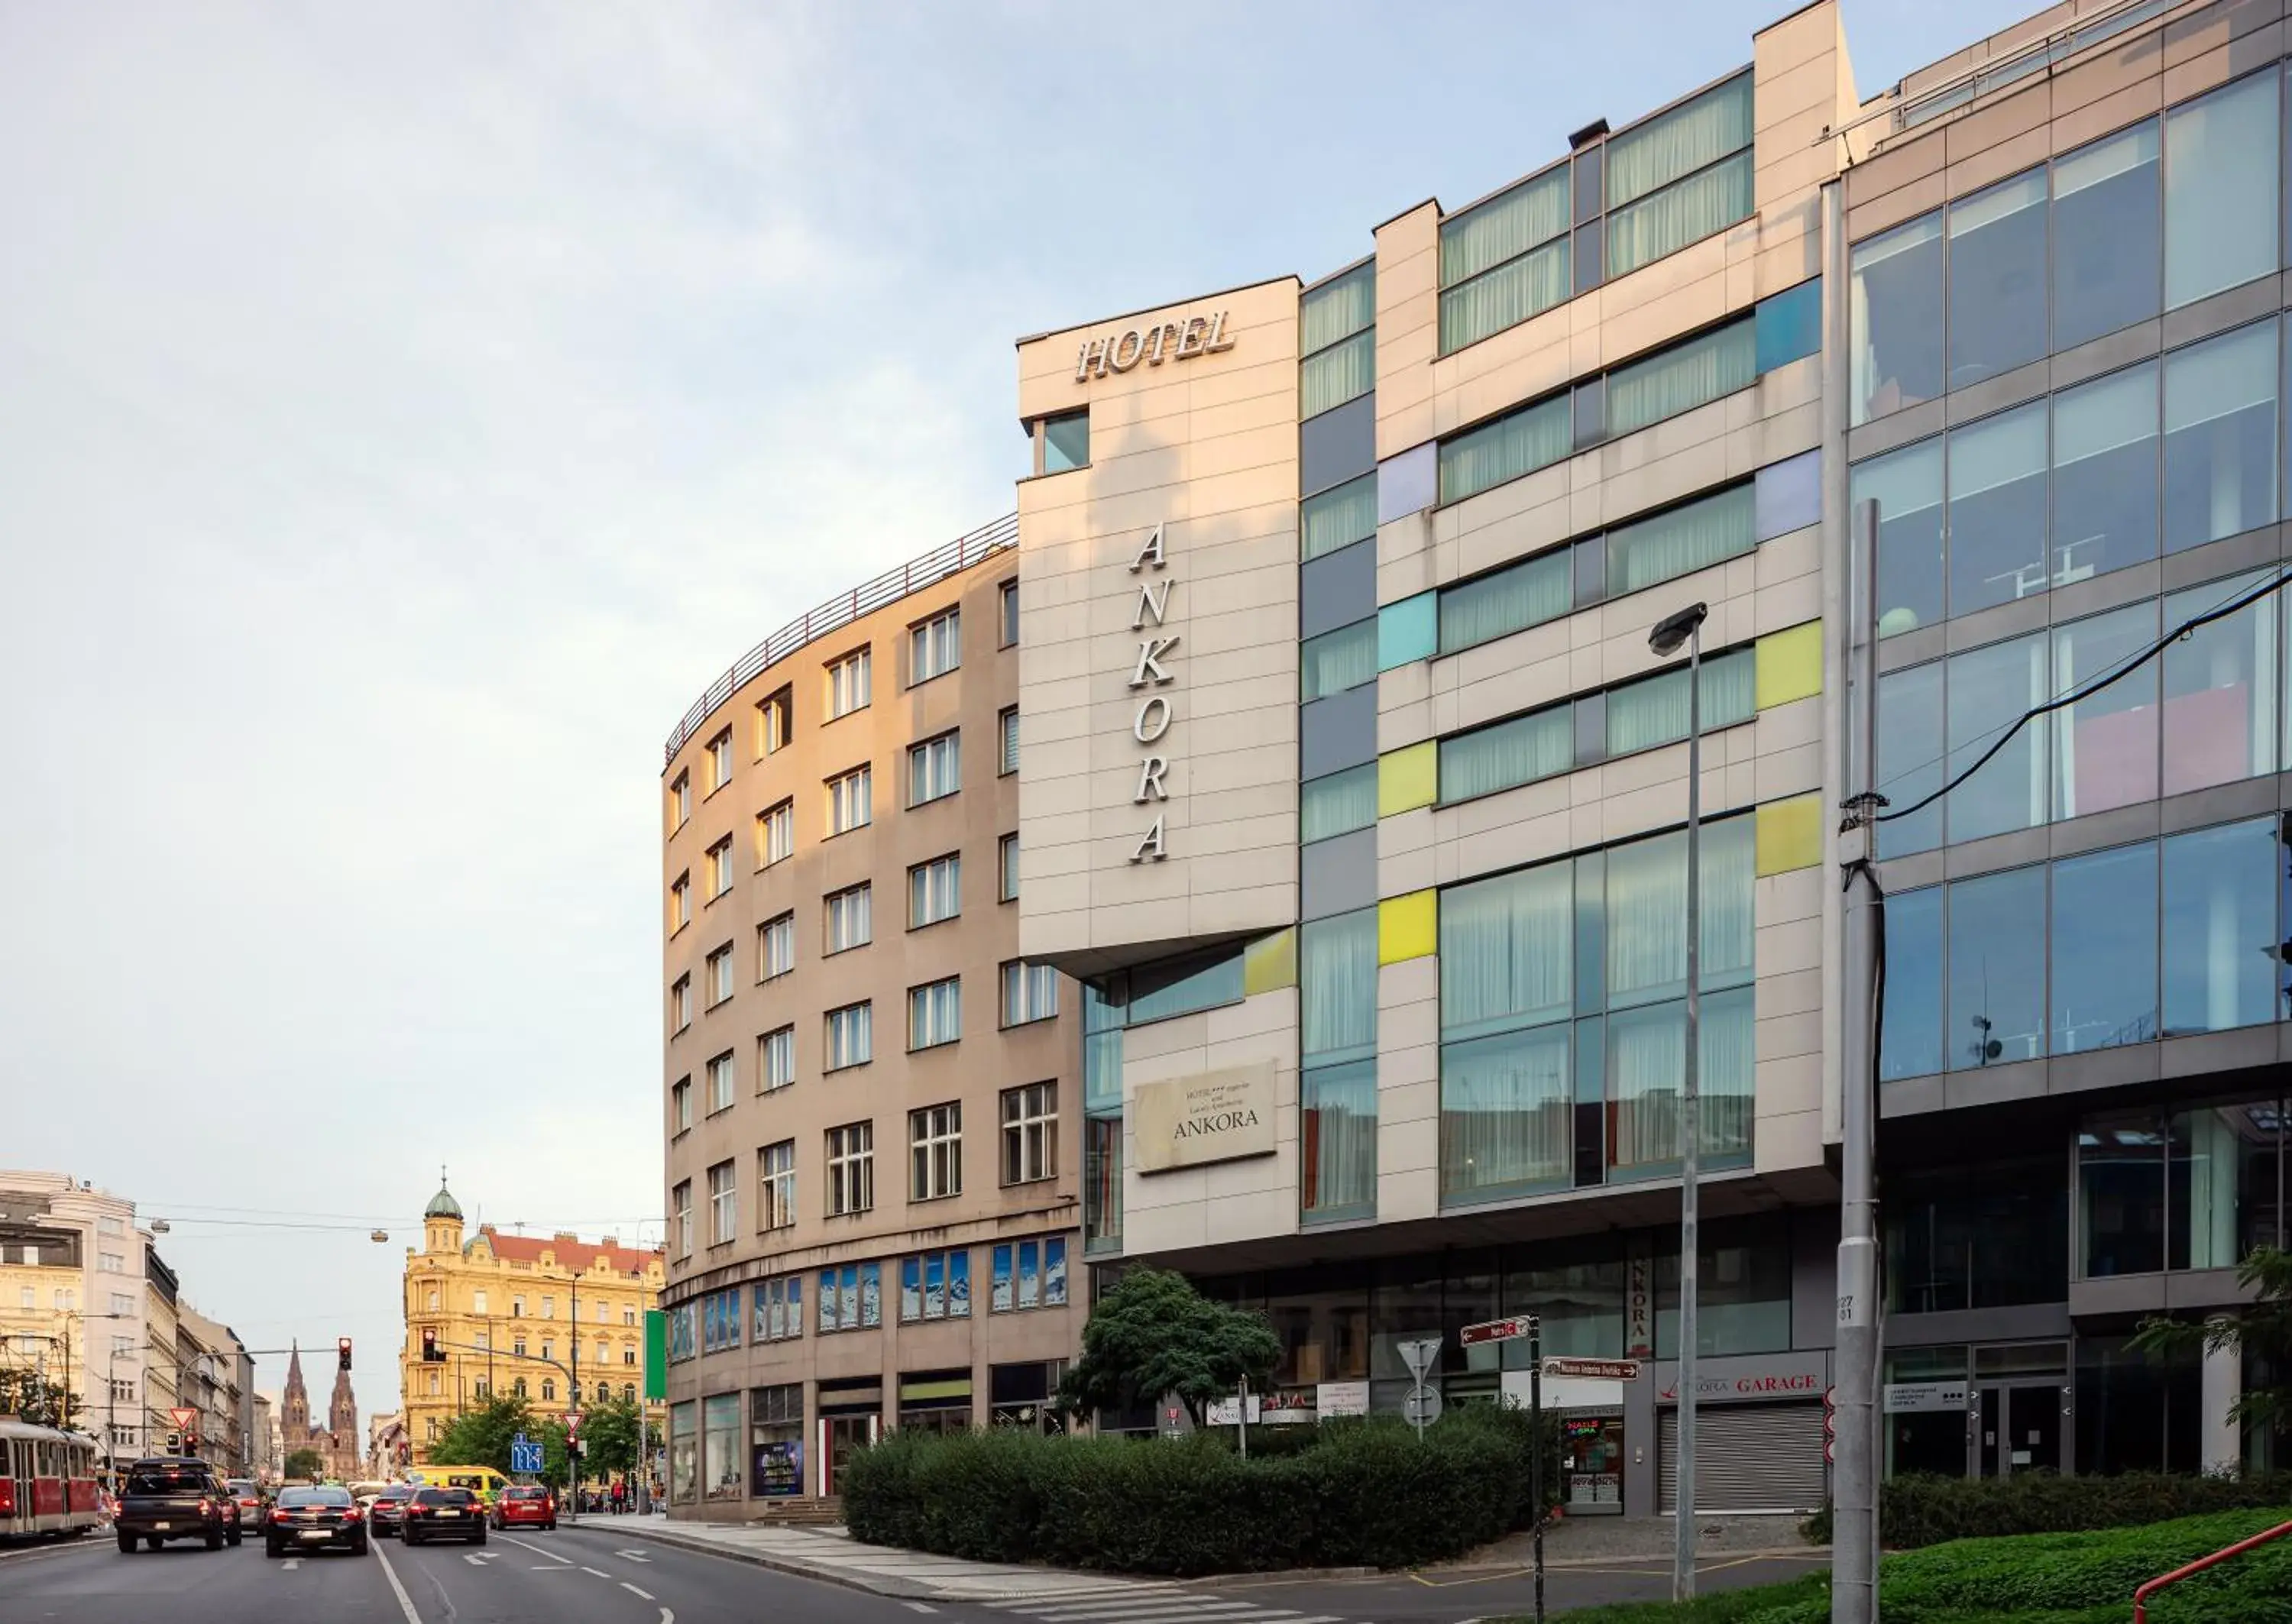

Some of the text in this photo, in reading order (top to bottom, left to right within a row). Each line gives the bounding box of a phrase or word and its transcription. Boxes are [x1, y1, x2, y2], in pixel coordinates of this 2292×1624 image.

[1075, 310, 1237, 382] HOTEL
[1128, 520, 1180, 865] ANKORA
[1174, 1109, 1260, 1139] ANKORA
[1737, 1373, 1818, 1393] GARAGE
